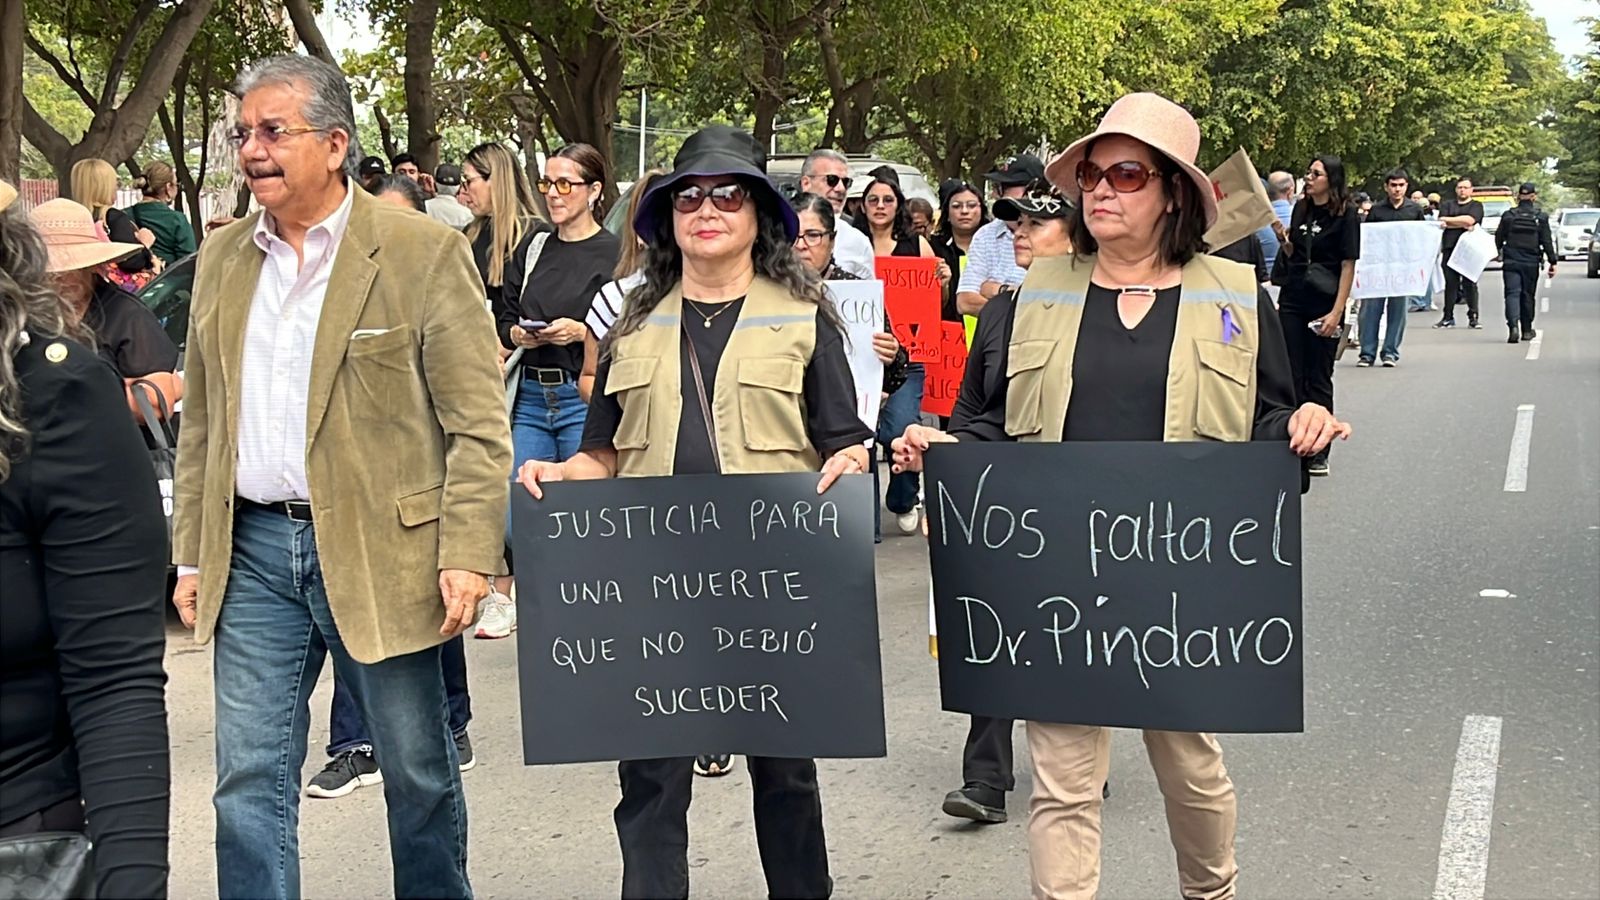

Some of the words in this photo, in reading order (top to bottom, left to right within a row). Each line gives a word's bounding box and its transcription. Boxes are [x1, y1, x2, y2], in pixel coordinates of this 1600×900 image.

[548, 502, 720, 538] JUSTICIA
[750, 499, 840, 541] PARA
[938, 464, 1045, 558] Nos
[561, 580, 622, 604] UNA
[653, 569, 808, 600] MUERTE
[553, 637, 615, 674] QUE
[643, 631, 684, 659] NO
[713, 622, 817, 654] DEBIÓ
[635, 685, 788, 722] SUCEDER
